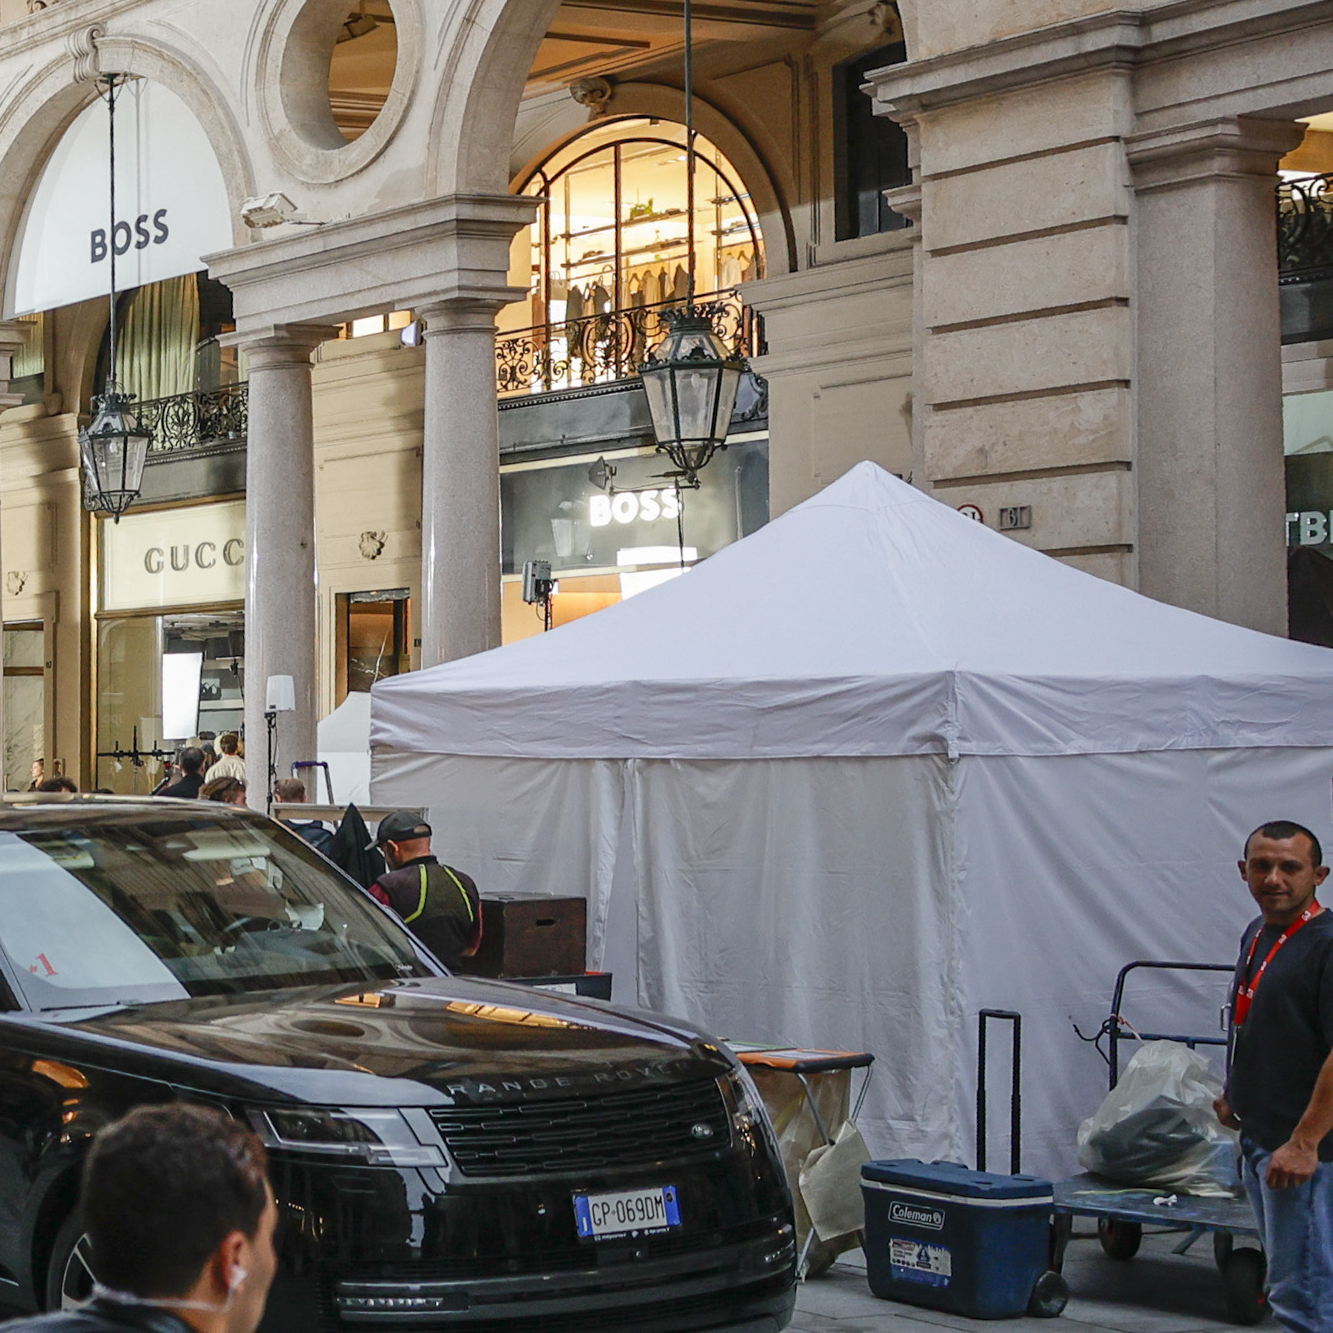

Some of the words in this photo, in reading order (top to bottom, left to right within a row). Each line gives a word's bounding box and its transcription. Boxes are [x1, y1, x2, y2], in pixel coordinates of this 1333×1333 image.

[90, 208, 169, 264] BOSS
[590, 487, 682, 527] BOSS
[446, 1076, 572, 1095] RANGE
[892, 1204, 933, 1223] Coleman
